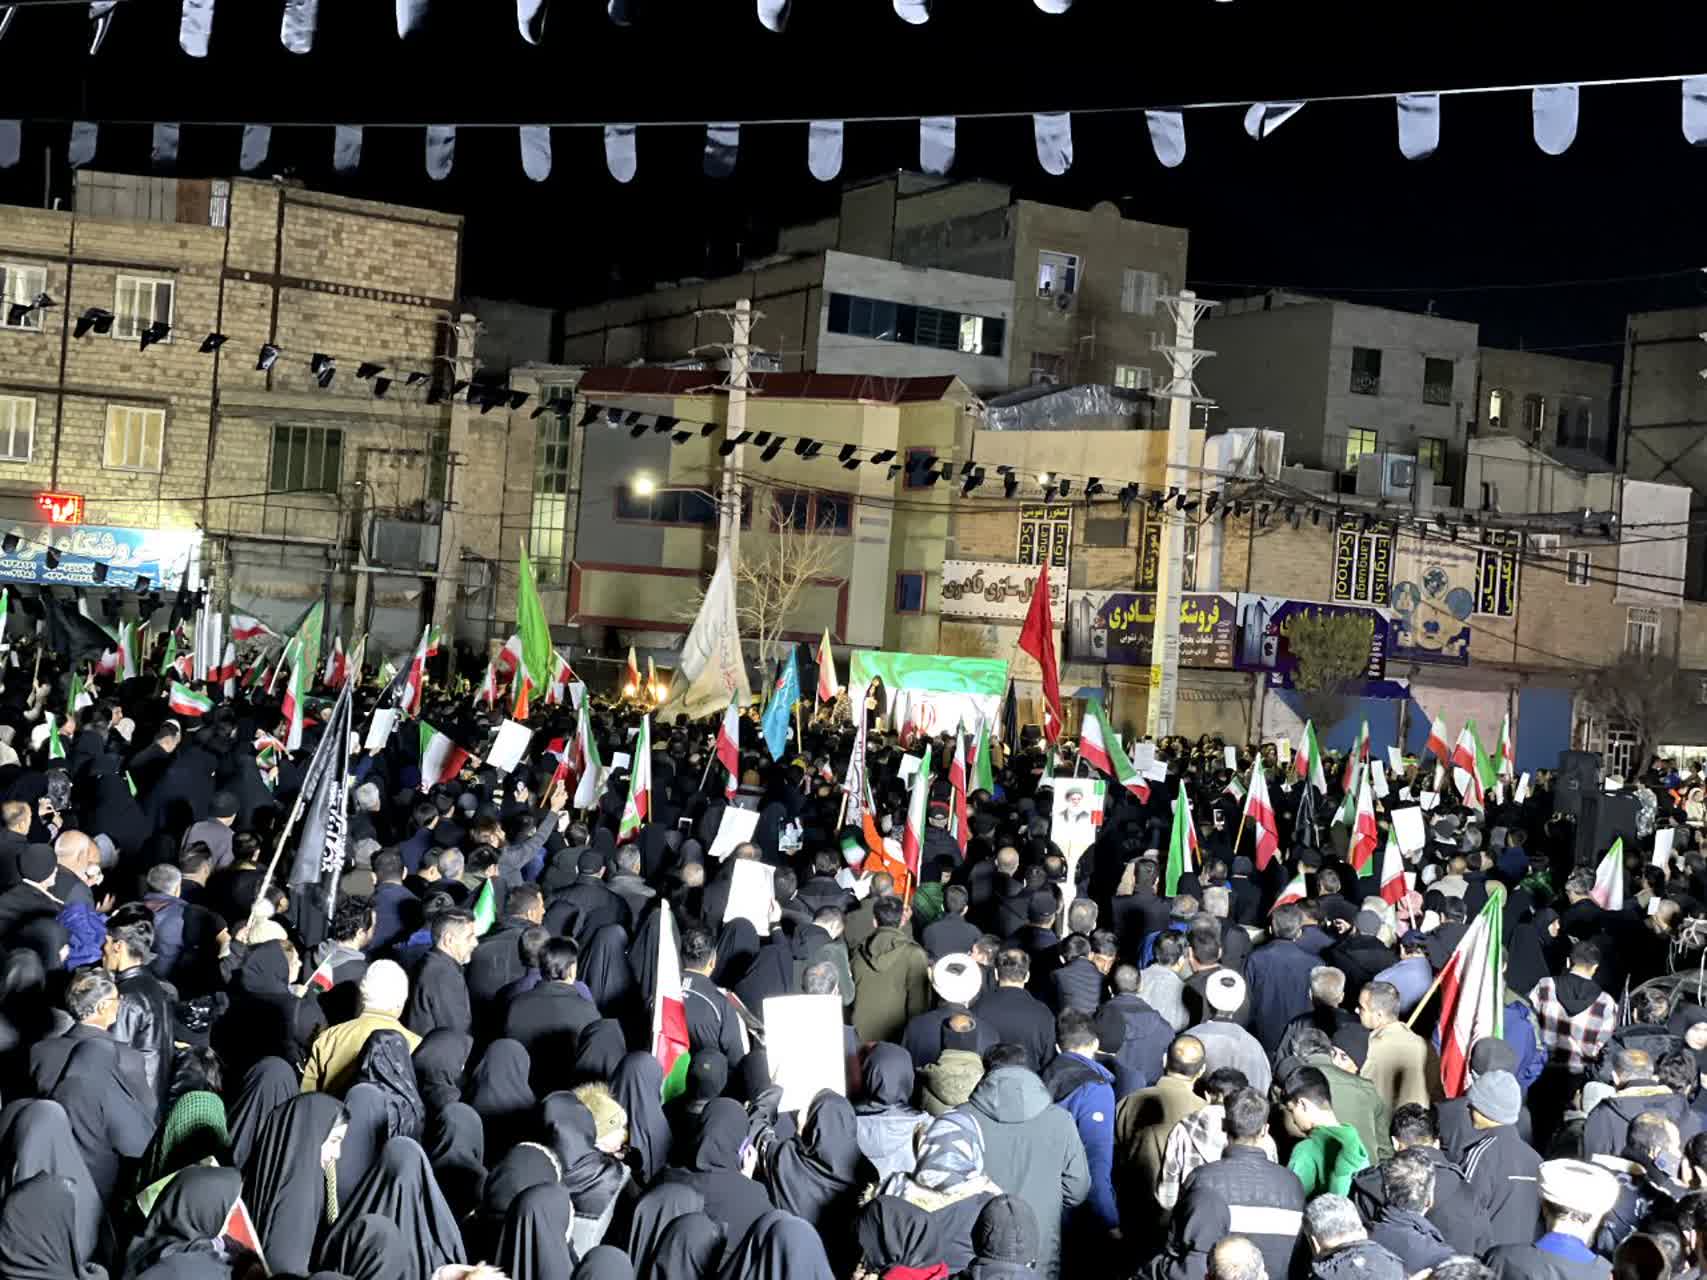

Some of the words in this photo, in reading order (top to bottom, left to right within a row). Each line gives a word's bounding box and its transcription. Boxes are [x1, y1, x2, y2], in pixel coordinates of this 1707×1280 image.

[1020, 523, 1034, 564] Scho
[1053, 523, 1068, 566] Engli
[1335, 534, 1354, 598] School
[1356, 538, 1371, 599] Language
[1374, 539, 1390, 602] English
[1179, 598, 1220, 633] فروشگ
